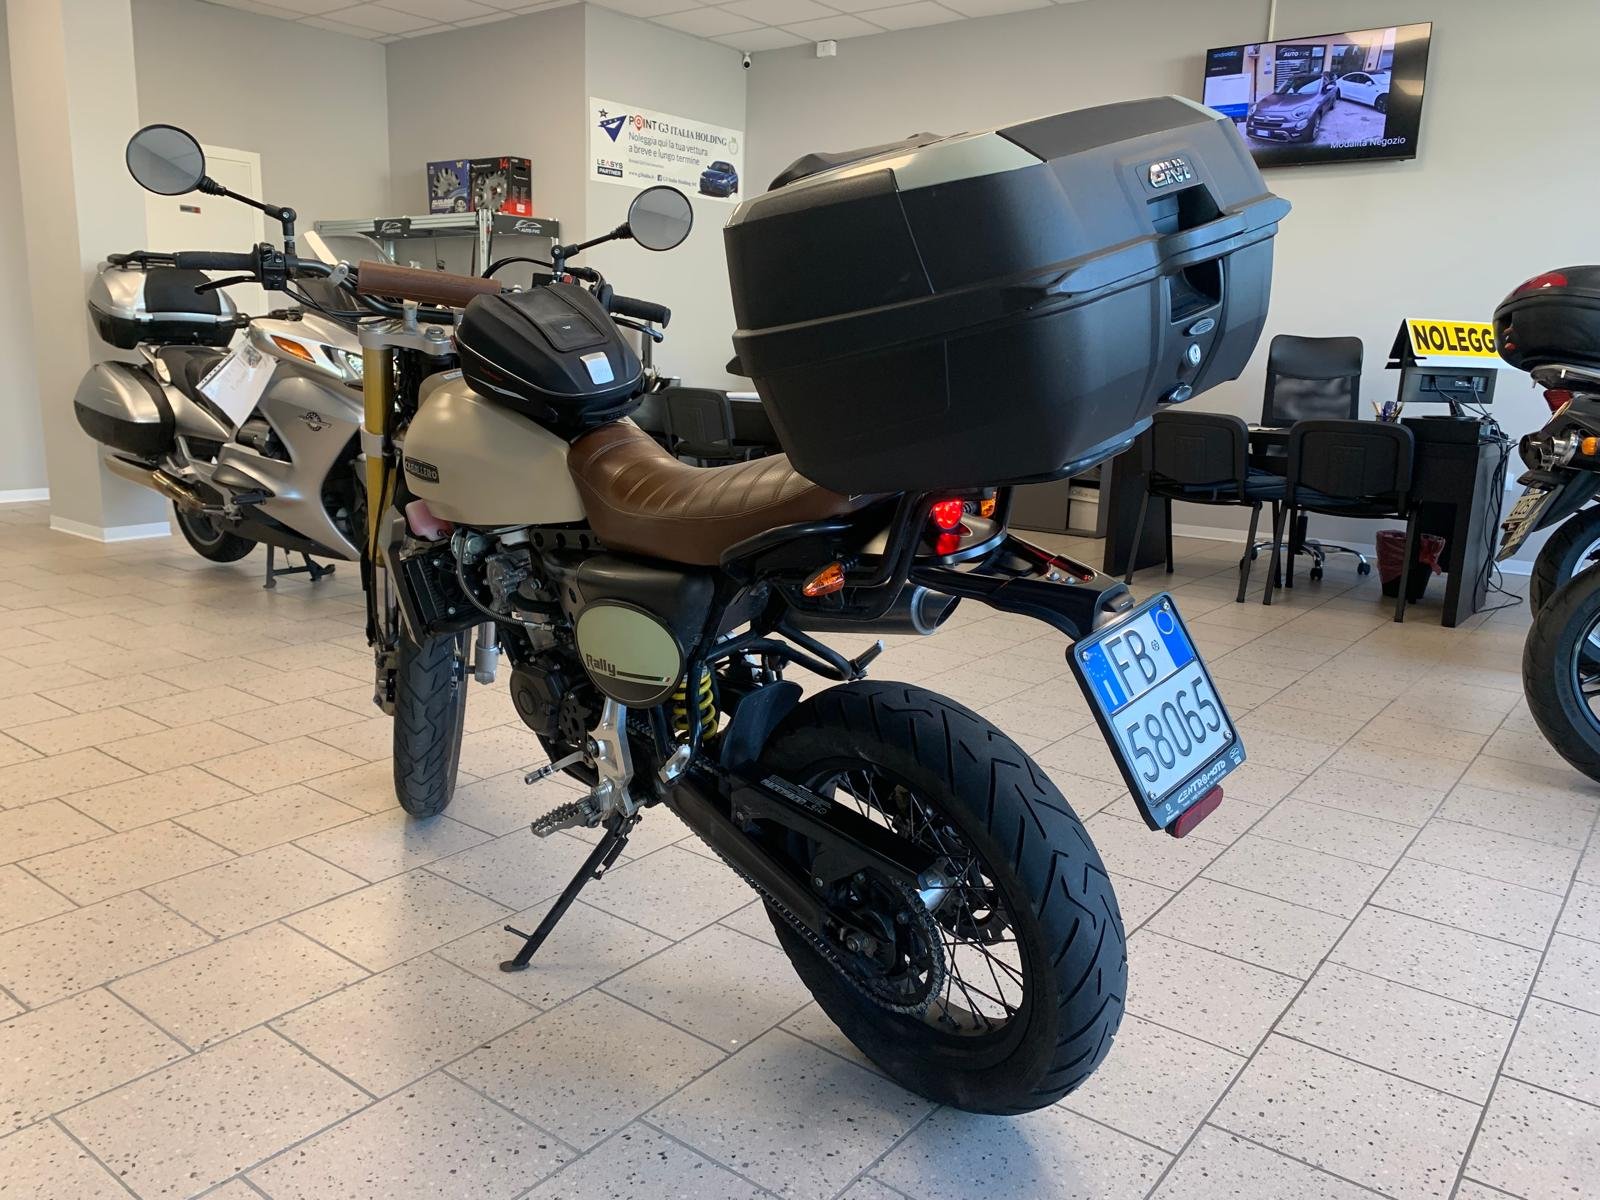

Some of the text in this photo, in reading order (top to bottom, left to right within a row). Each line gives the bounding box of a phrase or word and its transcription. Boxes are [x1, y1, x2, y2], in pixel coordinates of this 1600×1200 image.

[628, 115, 727, 146] POINT G3 ITALIA HOLDING
[1369, 136, 1406, 147] Negozio
[628, 132, 708, 156] Noleggia qui la tua vettura
[633, 145, 652, 157] breve
[658, 149, 676, 163] lungo
[676, 153, 700, 166] termine
[499, 158, 509, 169] 14
[596, 158, 623, 169] LEASYS
[599, 167, 622, 176] PARTNER
[1149, 158, 1191, 188] GIVI
[586, 653, 616, 677] Rally
[1105, 629, 1157, 697] FB
[1126, 675, 1222, 783] 58065
